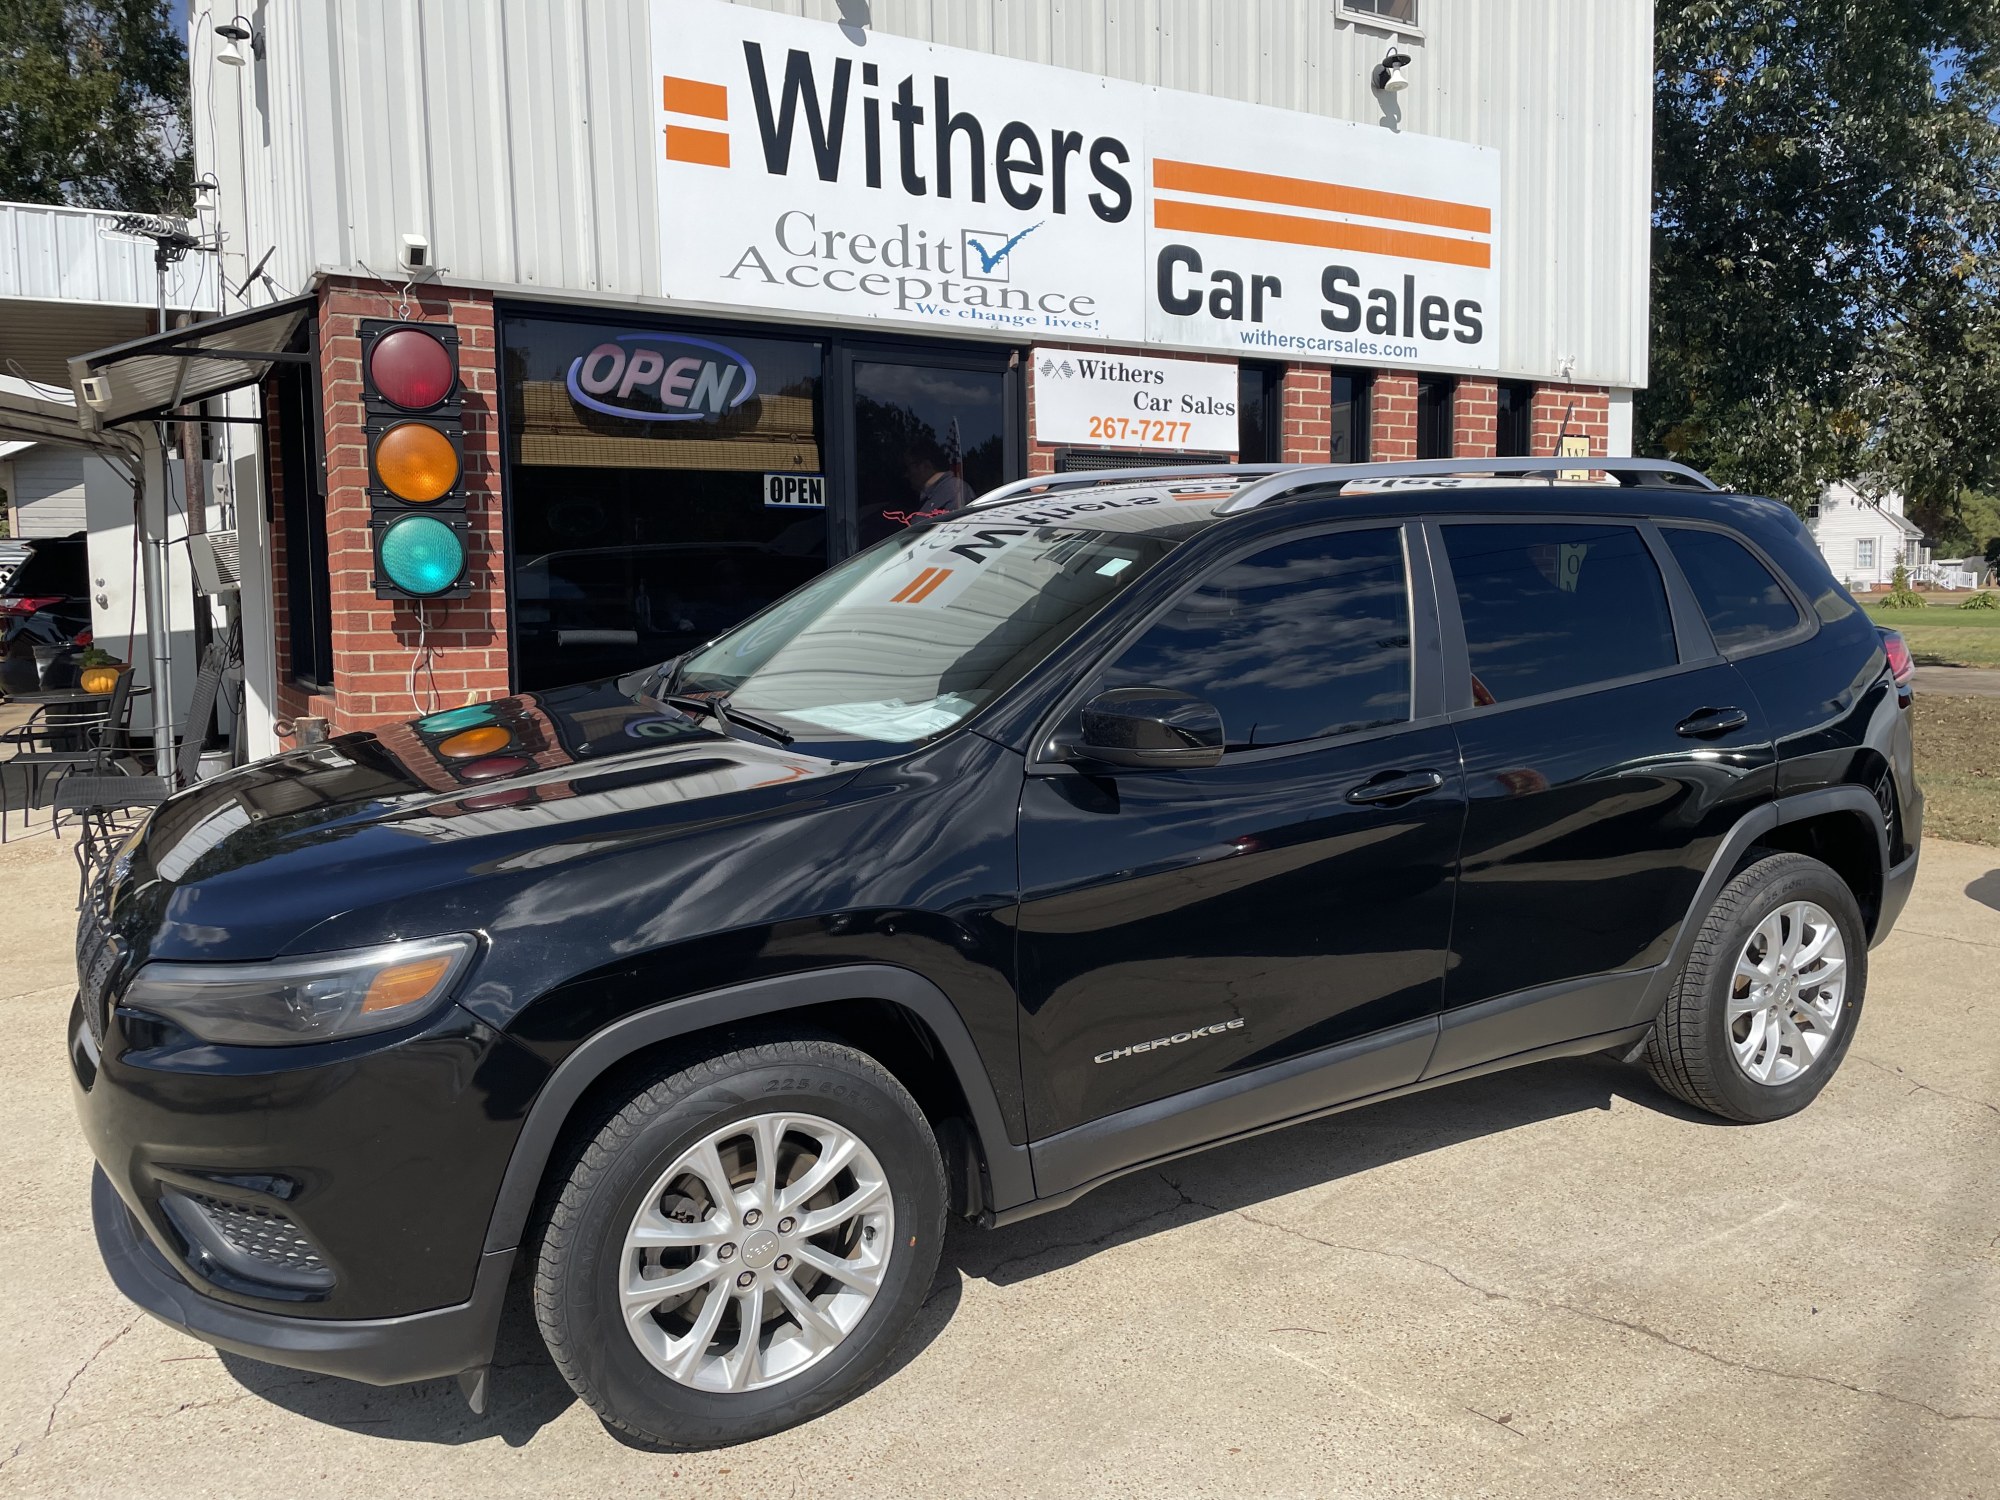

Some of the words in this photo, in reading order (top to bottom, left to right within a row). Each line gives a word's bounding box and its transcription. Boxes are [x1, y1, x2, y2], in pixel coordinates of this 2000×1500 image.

[742, 40, 1134, 224] Withers
[775, 210, 955, 274] Credit
[720, 245, 1096, 317] Acceptance
[1156, 243, 1282, 323] Car
[1320, 264, 1484, 345] Sales
[914, 302, 950, 318] We
[958, 308, 1037, 328] change
[1044, 315, 1100, 331] lives!
[1240, 328, 1418, 359] witherscarsales.com
[580, 342, 738, 413] OPEN
[1077, 358, 1164, 385] Withers
[1133, 390, 1173, 412] Car
[1181, 394, 1236, 416] Sales
[1089, 415, 1192, 443] 267-7277
[769, 475, 823, 505] OPEN
[1094, 1017, 1245, 1064] CHEROKEE
